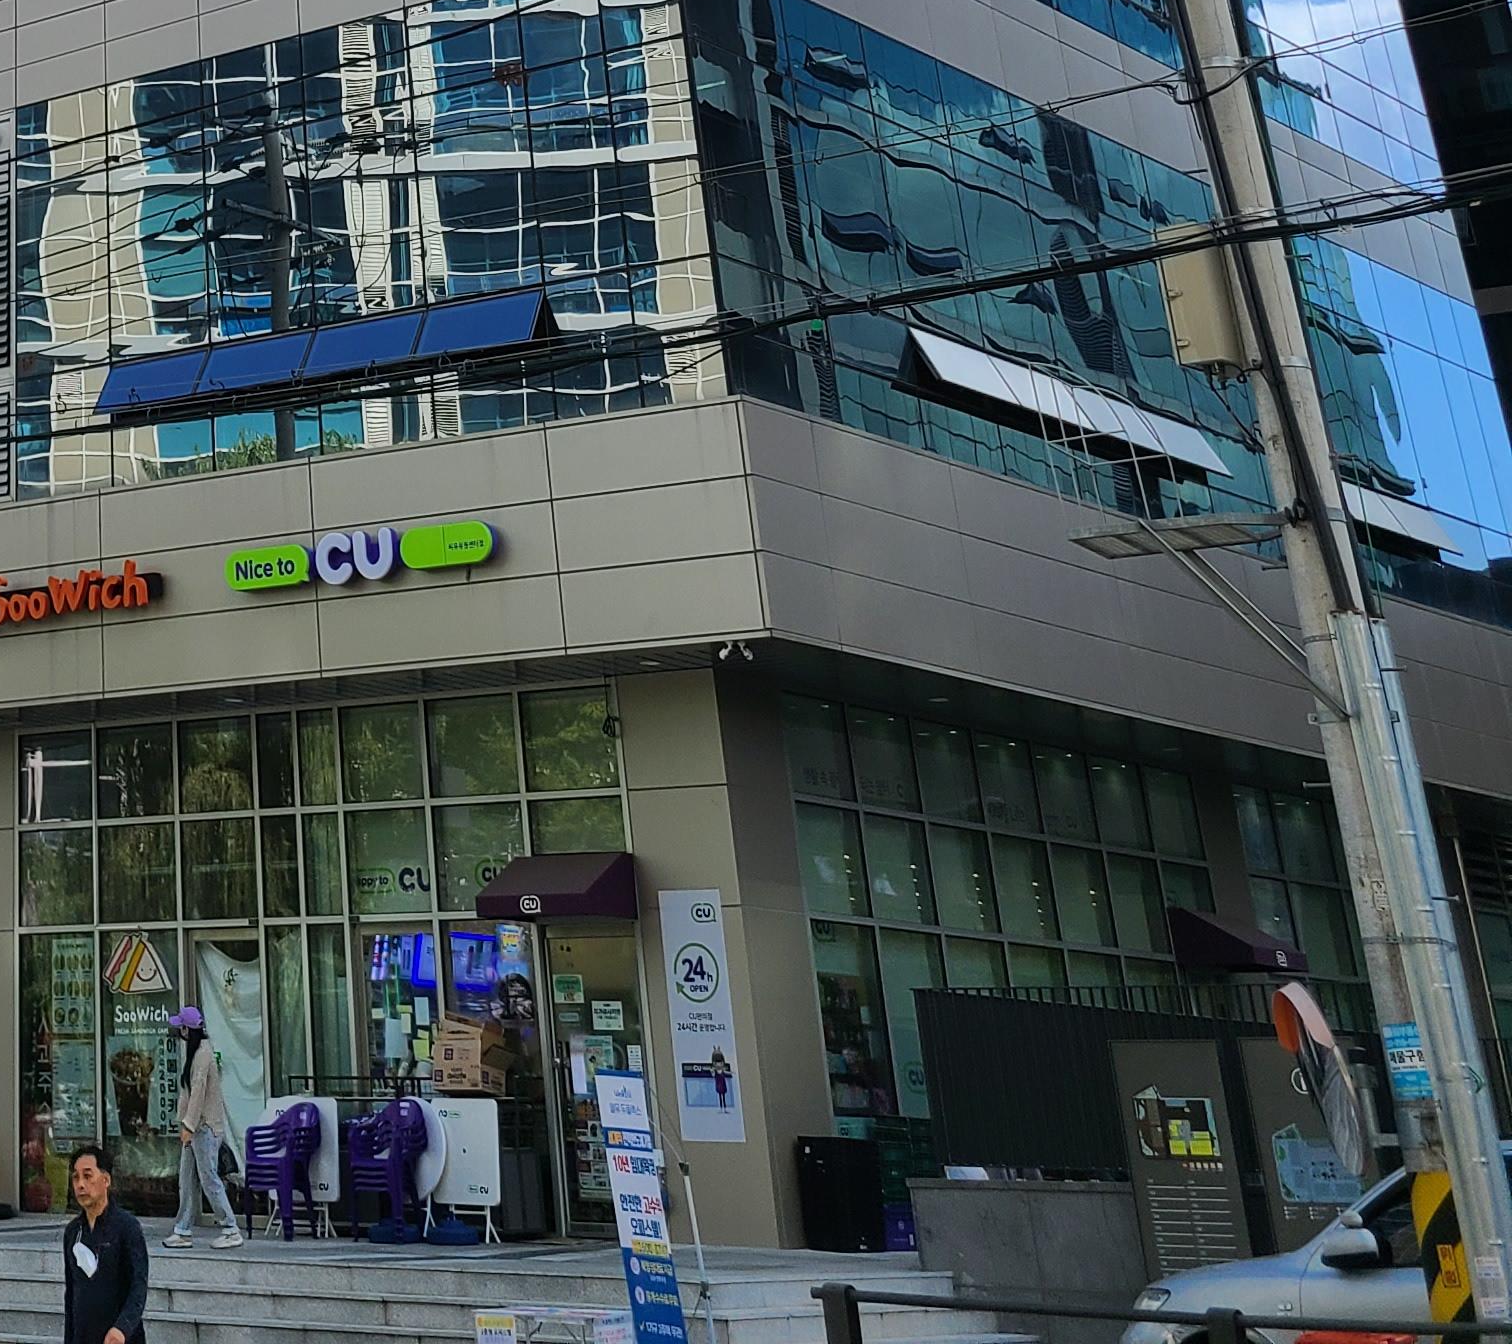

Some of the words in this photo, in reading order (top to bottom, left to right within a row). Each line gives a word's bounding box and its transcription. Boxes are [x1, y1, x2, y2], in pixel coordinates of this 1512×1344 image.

[234, 554, 274, 582] Nice
[275, 556, 296, 577] to
[316, 527, 395, 586] CU
[398, 866, 431, 893] CU
[523, 898, 537, 909] CU
[695, 908, 711, 918] CU
[689, 984, 709, 993] OPEN
[113, 1003, 169, 1023] SooWich
[620, 1193, 643, 1214] 안전한
